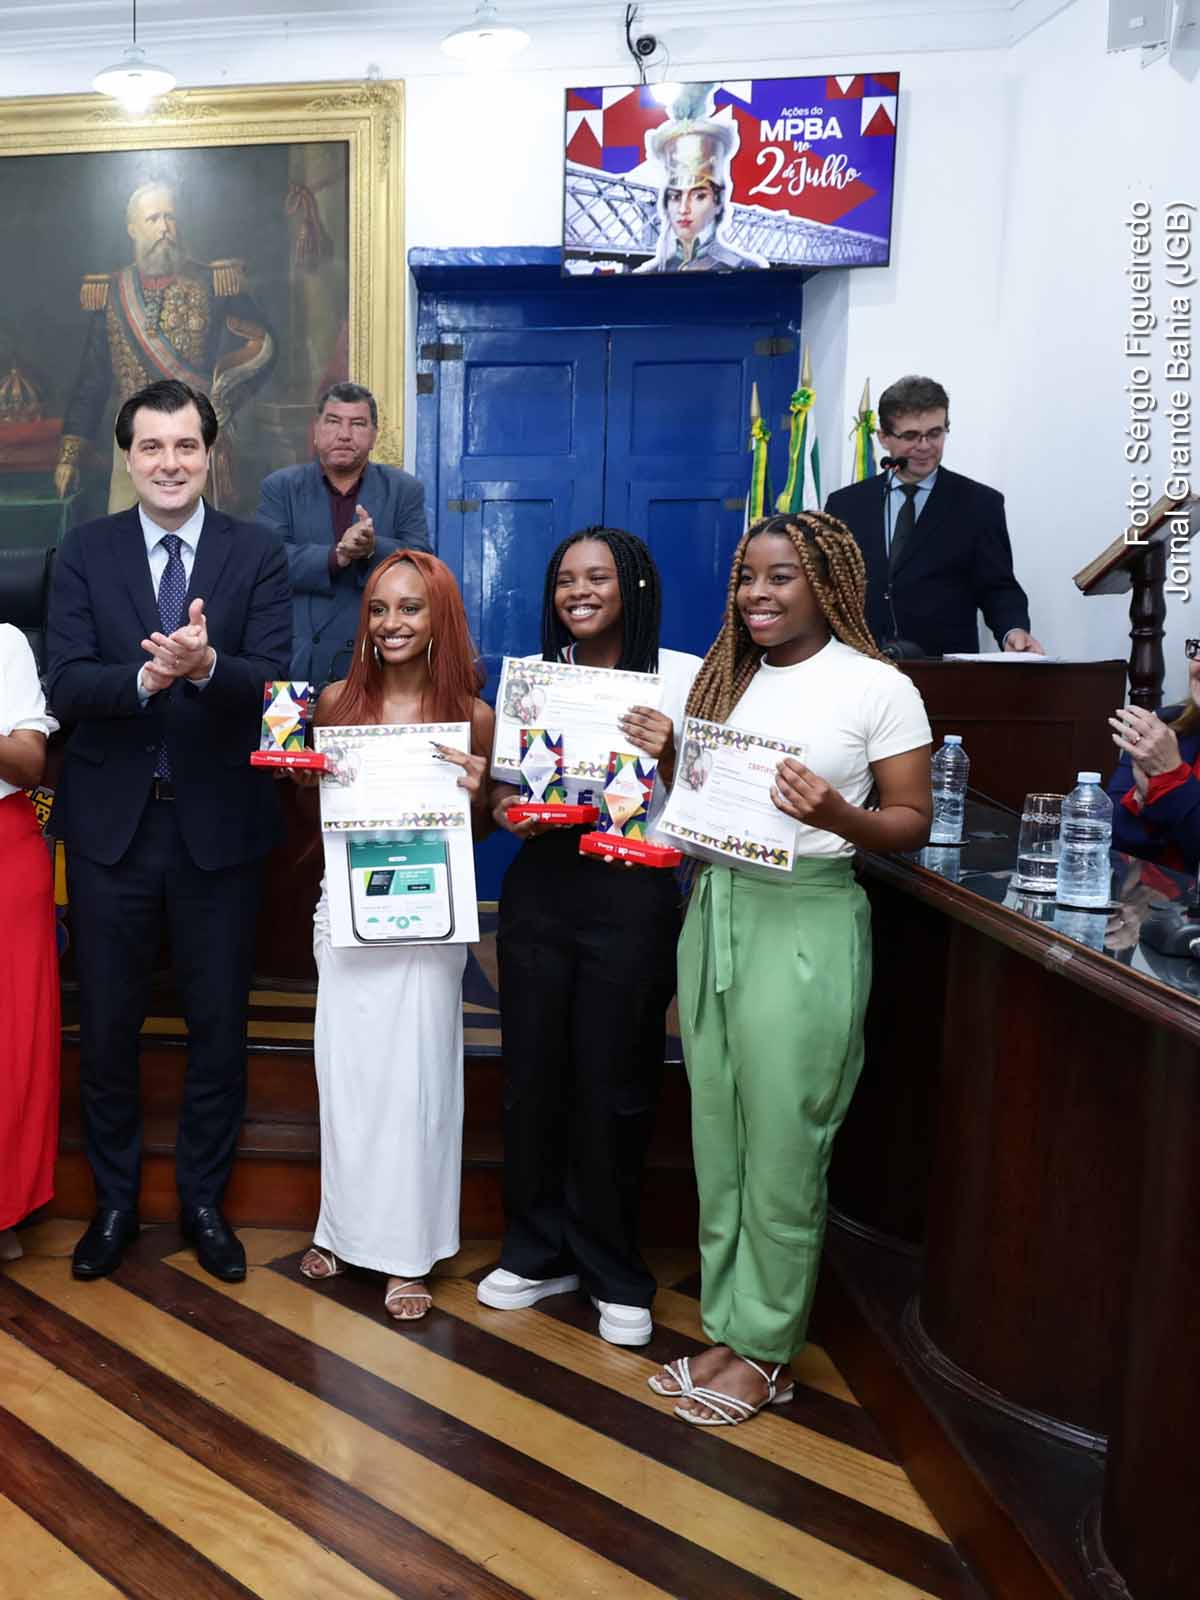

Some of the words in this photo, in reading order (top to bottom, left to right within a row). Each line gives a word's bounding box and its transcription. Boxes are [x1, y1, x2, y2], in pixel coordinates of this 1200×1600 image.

[781, 107, 809, 117] Ações
[810, 106, 823, 115] do
[760, 116, 843, 142] MPBA
[793, 141, 812, 152] no
[748, 146, 785, 195] 2
[782, 164, 796, 178] de
[787, 153, 861, 195] Julho
